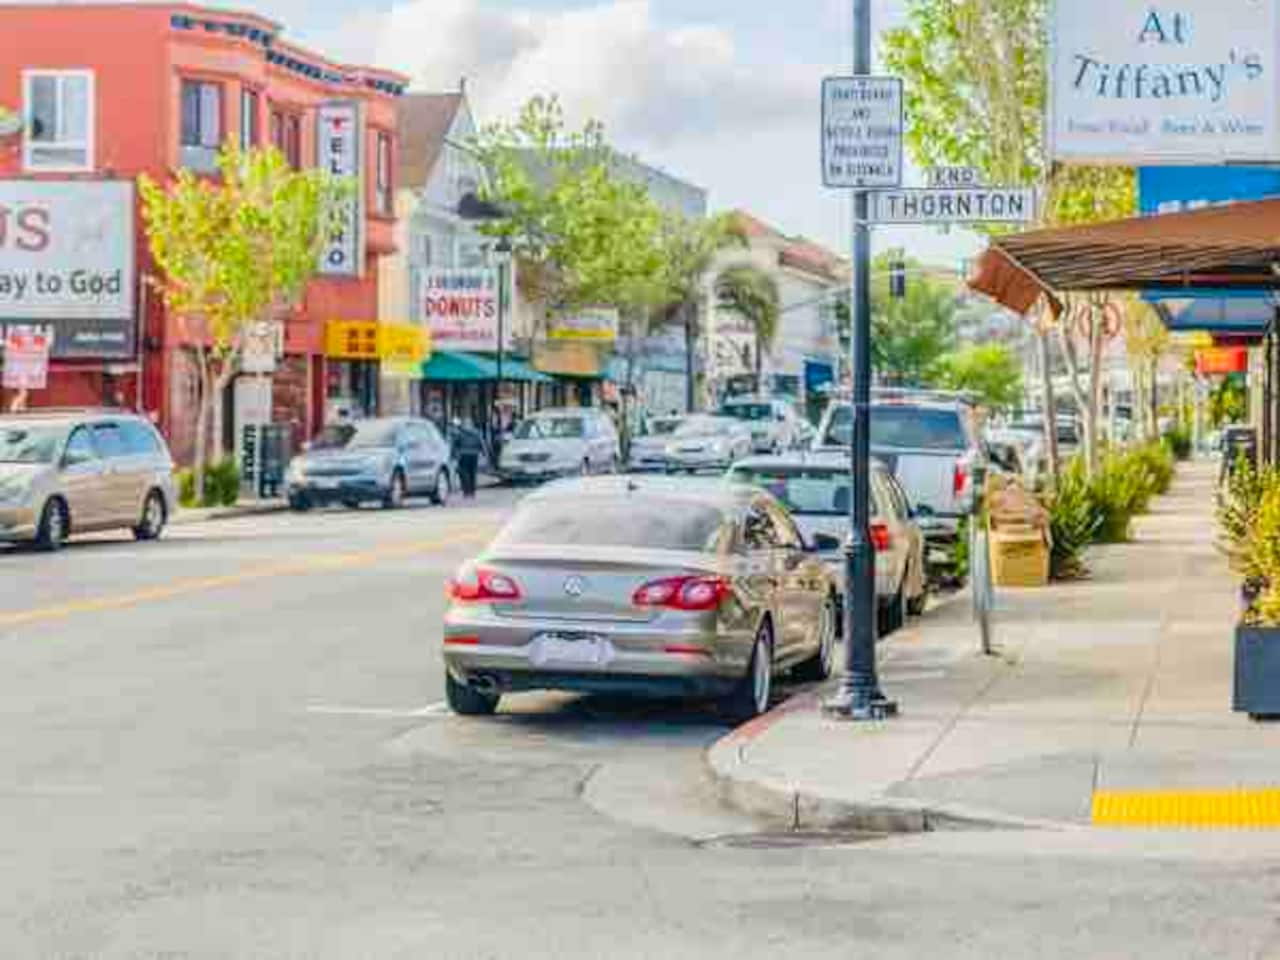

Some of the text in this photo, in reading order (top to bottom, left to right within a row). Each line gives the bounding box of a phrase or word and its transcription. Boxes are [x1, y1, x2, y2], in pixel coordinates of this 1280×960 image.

[1139, 12, 1186, 43] At
[1073, 48, 1264, 102] Tiffany's
[935, 168, 974, 183] END
[888, 194, 1024, 218] THORNTON
[36, 271, 62, 294] to
[71, 269, 121, 294] God
[425, 296, 496, 318] DONUTS
